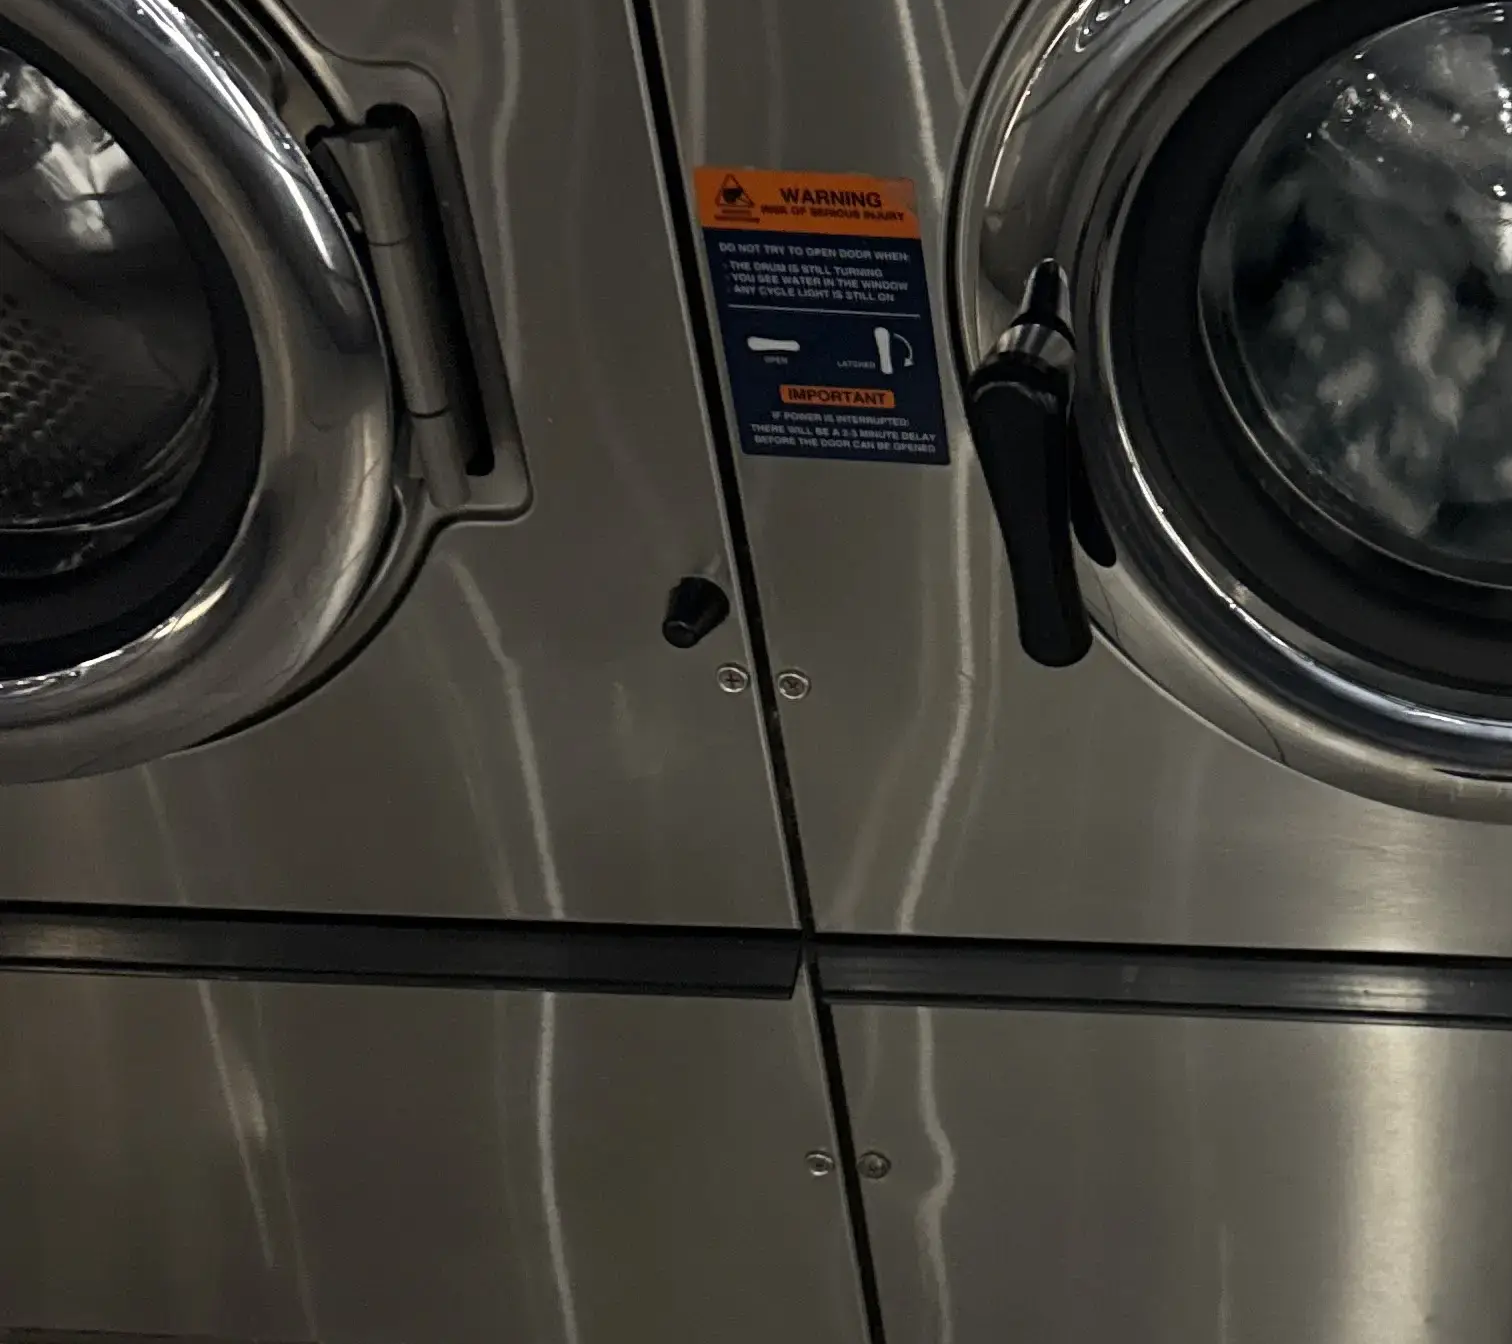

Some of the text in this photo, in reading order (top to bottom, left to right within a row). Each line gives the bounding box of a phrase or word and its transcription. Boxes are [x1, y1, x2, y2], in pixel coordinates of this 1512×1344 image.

[779, 187, 883, 209] WARNING
[737, 242, 761, 254] NOT
[763, 244, 785, 255] TRY
[787, 245, 803, 256] TO
[805, 246, 837, 258] OPEN
[838, 248, 872, 259] DOOR
[729, 260, 883, 278] THE DRUM IS STILL TURNING
[731, 272, 755, 283] YOU
[780, 274, 821, 287] WATER
[822, 277, 835, 287] IN
[837, 278, 859, 289] THE
[861, 279, 909, 291] WINDOW
[733, 284, 757, 295] ANY
[758, 285, 795, 297] CYCLE
[832, 289, 843, 300] IS
[845, 290, 874, 302] STILL
[878, 292, 896, 303] ON
[788, 387, 886, 405] IMPORTANT
[783, 411, 822, 423] POWER
[752, 423, 785, 435] THERE
[901, 431, 936, 443] DELAY
